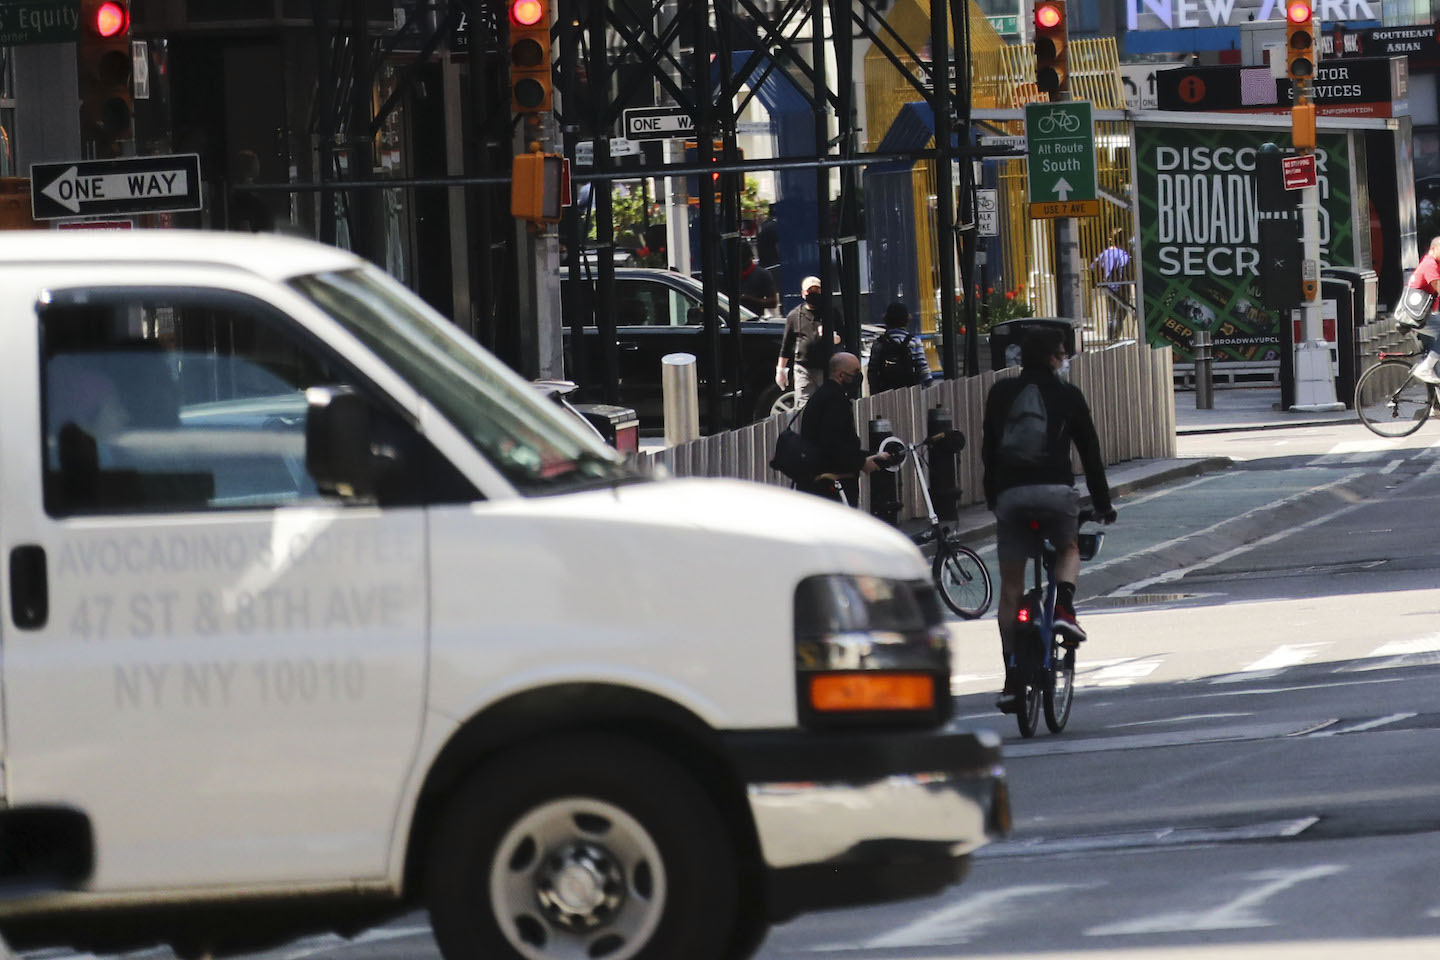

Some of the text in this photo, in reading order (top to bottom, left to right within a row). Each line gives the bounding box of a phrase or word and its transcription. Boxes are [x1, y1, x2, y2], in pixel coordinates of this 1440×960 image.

[19, 5, 79, 32] Equity
[1372, 28, 1435, 41] SOUTHEAST
[1386, 41, 1421, 53] ASIAN
[1288, 85, 1361, 100] SRVICES
[1322, 107, 1373, 115] INFORMATION
[633, 117, 695, 131] ONE WA
[1038, 143, 1083, 154] Alt Route
[1042, 160, 1081, 172] South
[1156, 146, 1328, 172] DISCOR
[58, 173, 177, 200] ONE WAY
[1043, 203, 1086, 214] USE 7 AVE
[979, 213, 992, 221] ALK
[980, 223, 991, 231] IKE
[1159, 246, 1331, 276] SECRS
[290, 527, 413, 565] COFFEE
[71, 584, 403, 639] 47 ST & 8TH AVE
[113, 657, 366, 710] NY NY 10010
